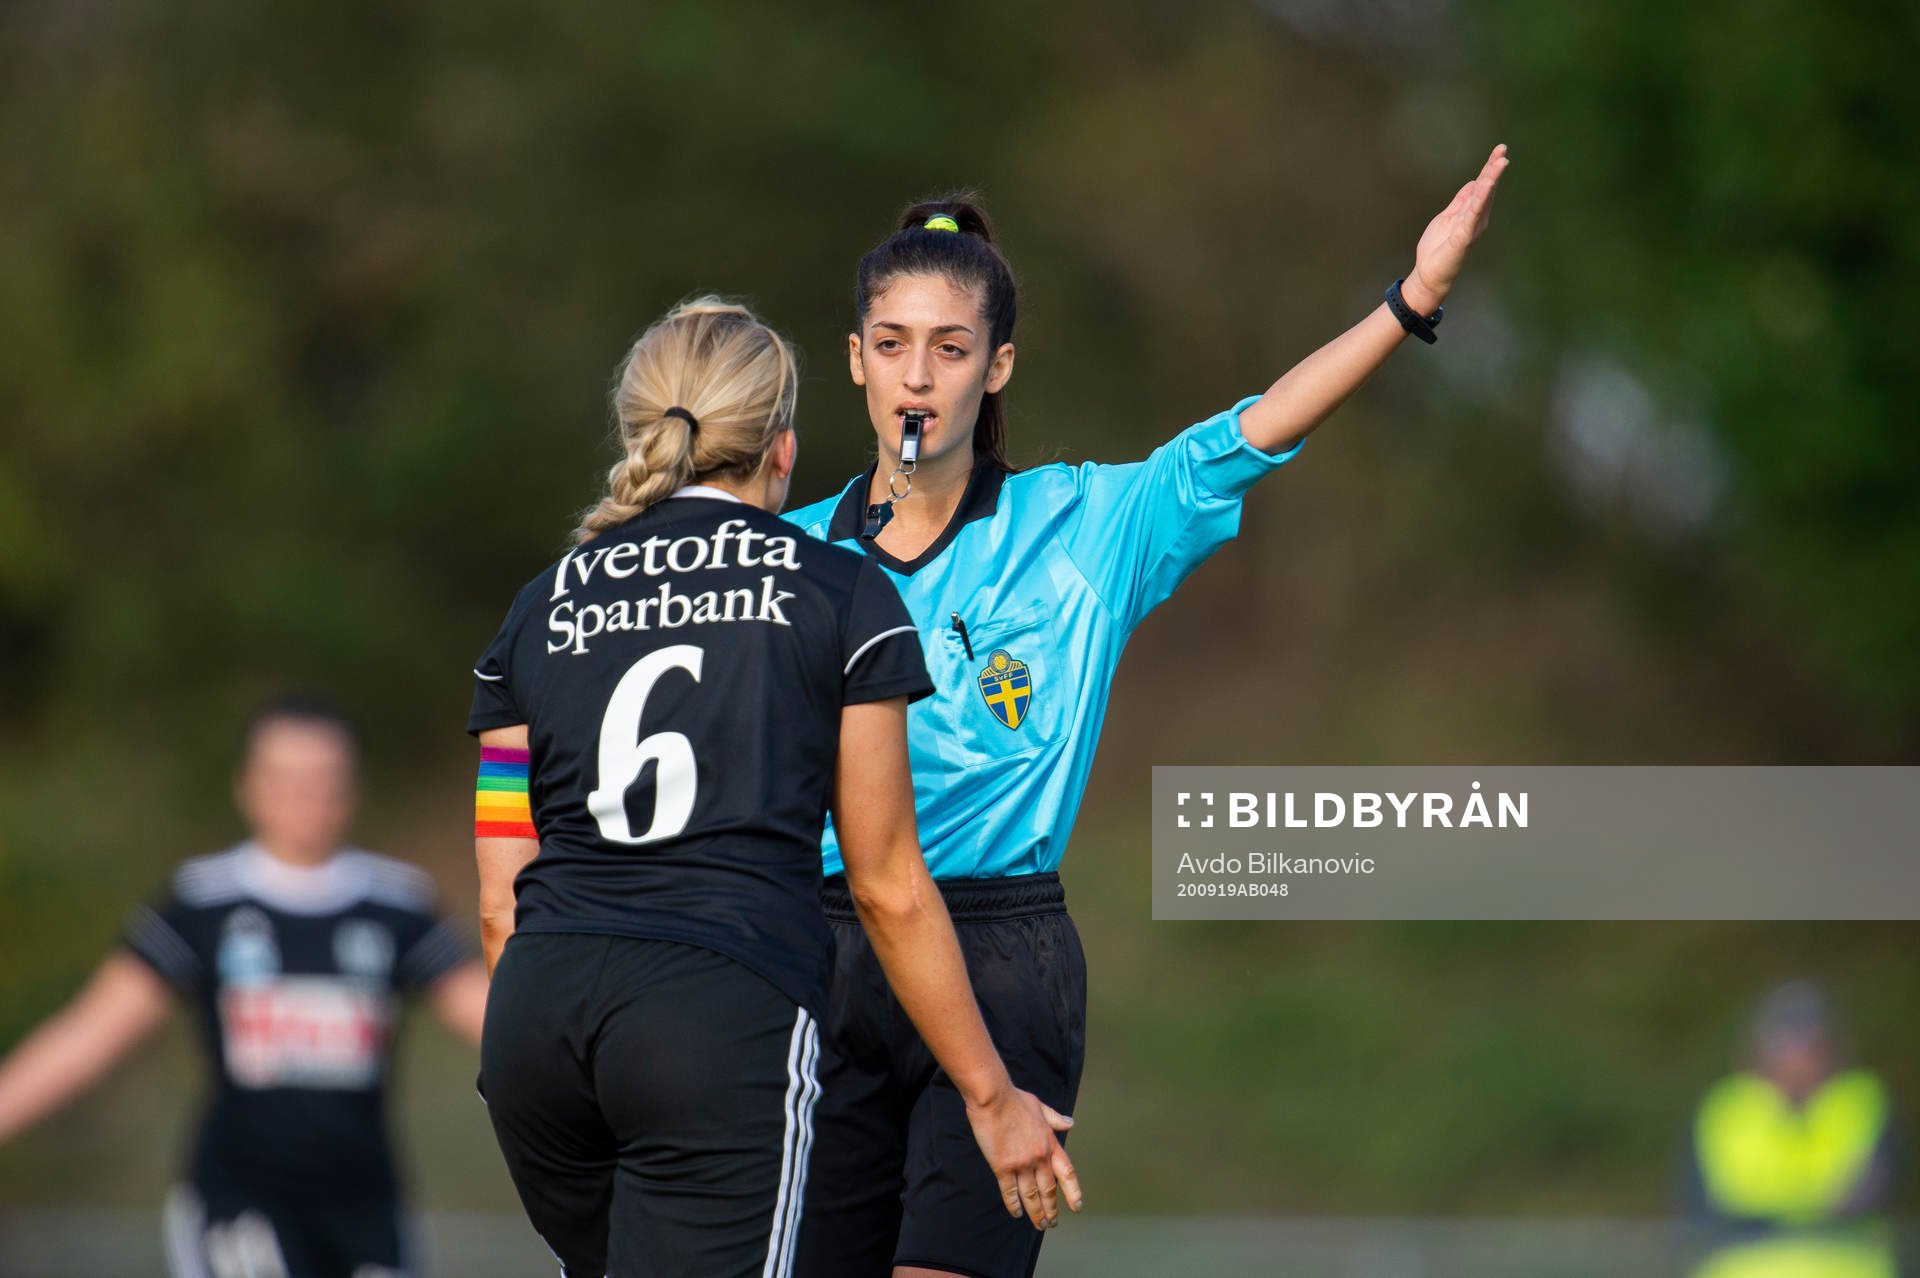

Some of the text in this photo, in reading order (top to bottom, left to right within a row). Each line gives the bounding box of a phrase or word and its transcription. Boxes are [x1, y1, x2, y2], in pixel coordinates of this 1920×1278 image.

[549, 519, 801, 602] Ivetofta
[547, 575, 796, 655] Sparbank
[587, 644, 704, 844] 6
